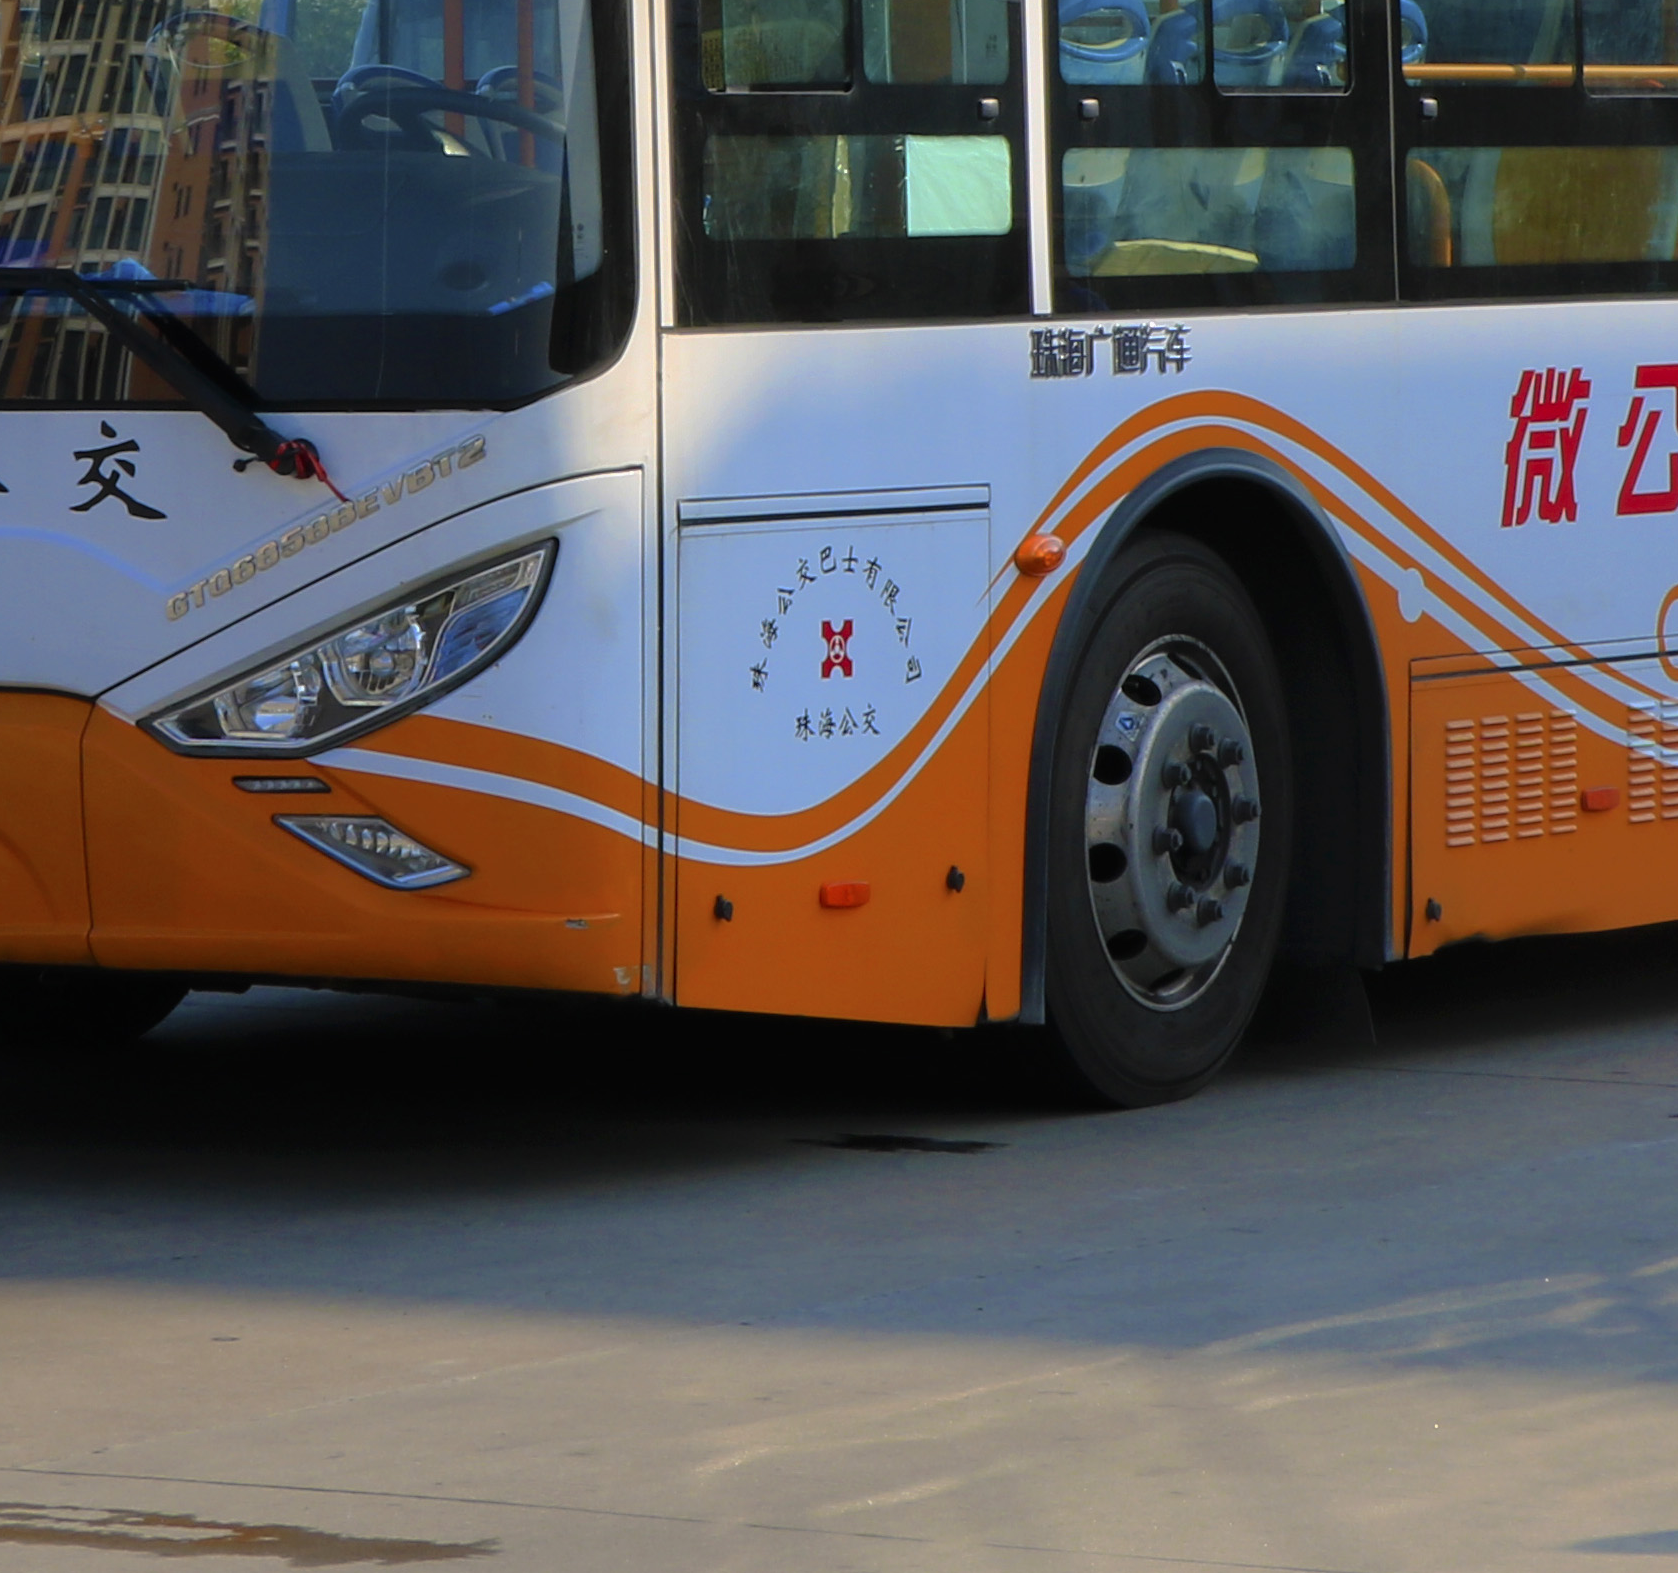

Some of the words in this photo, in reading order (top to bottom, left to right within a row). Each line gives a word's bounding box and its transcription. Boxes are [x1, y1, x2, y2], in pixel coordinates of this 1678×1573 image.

[1030, 323, 1193, 378] 珠海广通汽车
[166, 434, 487, 621] GTQ6858BEVBT2
[749, 544, 922, 693] 珠海公交巴士有限公司
[795, 703, 881, 742] 珠海公交
